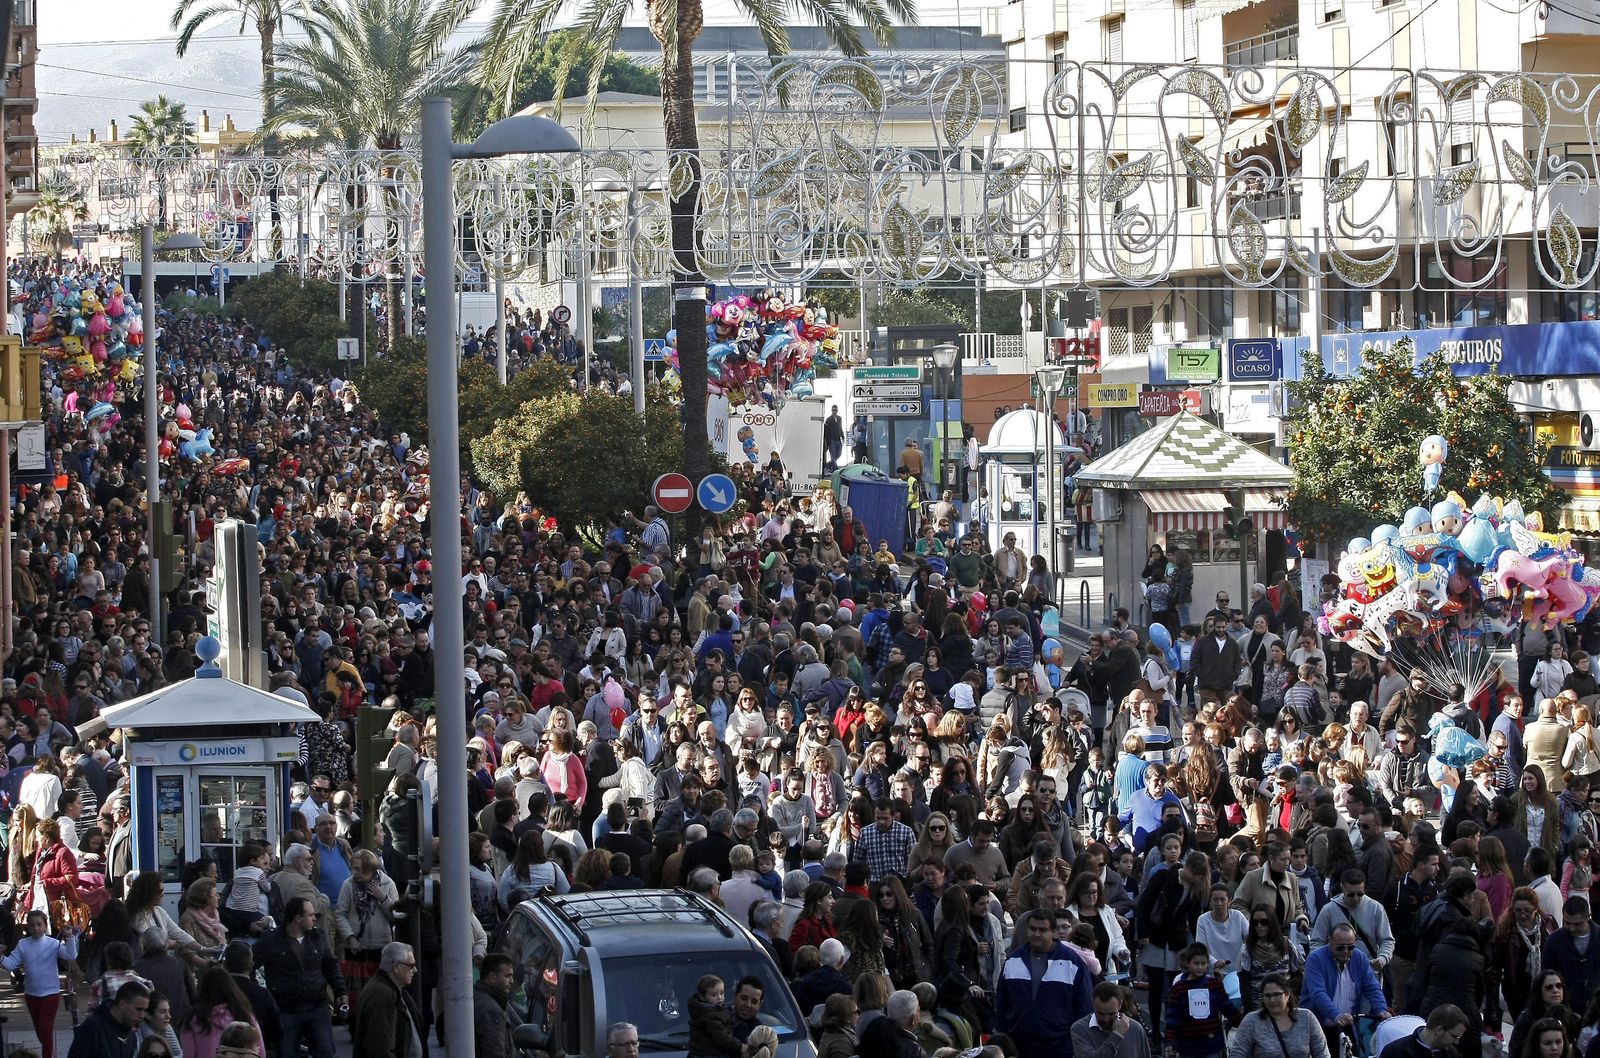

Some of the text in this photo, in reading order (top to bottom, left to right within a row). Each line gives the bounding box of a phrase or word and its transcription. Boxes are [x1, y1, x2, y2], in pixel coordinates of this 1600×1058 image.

[1440, 338, 1502, 364] SEGUROS
[1236, 364, 1270, 372] OCASO
[1097, 389, 1127, 401] COMPRO ORO
[744, 415, 774, 424] TNT
[1561, 449, 1581, 465] FOTO
[200, 746, 246, 756] ILUNION
